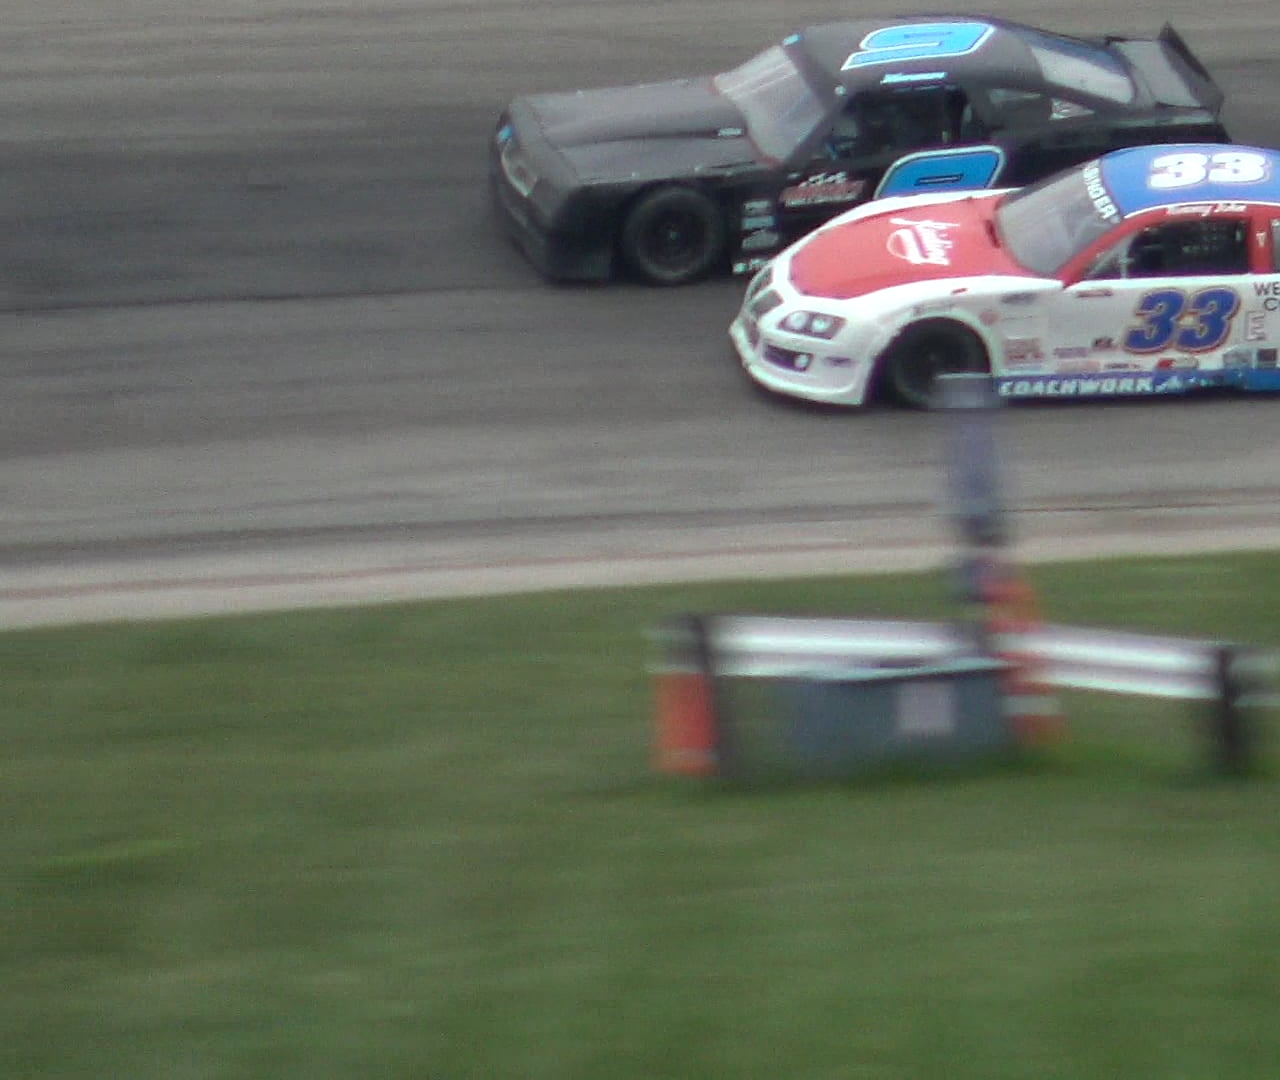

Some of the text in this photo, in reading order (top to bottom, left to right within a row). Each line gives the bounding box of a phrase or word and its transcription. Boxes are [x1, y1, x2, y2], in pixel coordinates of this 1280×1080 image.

[840, 22, 996, 71] 9
[1147, 152, 1271, 190] 33
[1123, 287, 1242, 354] 33
[998, 376, 1153, 396] COACHWORK
